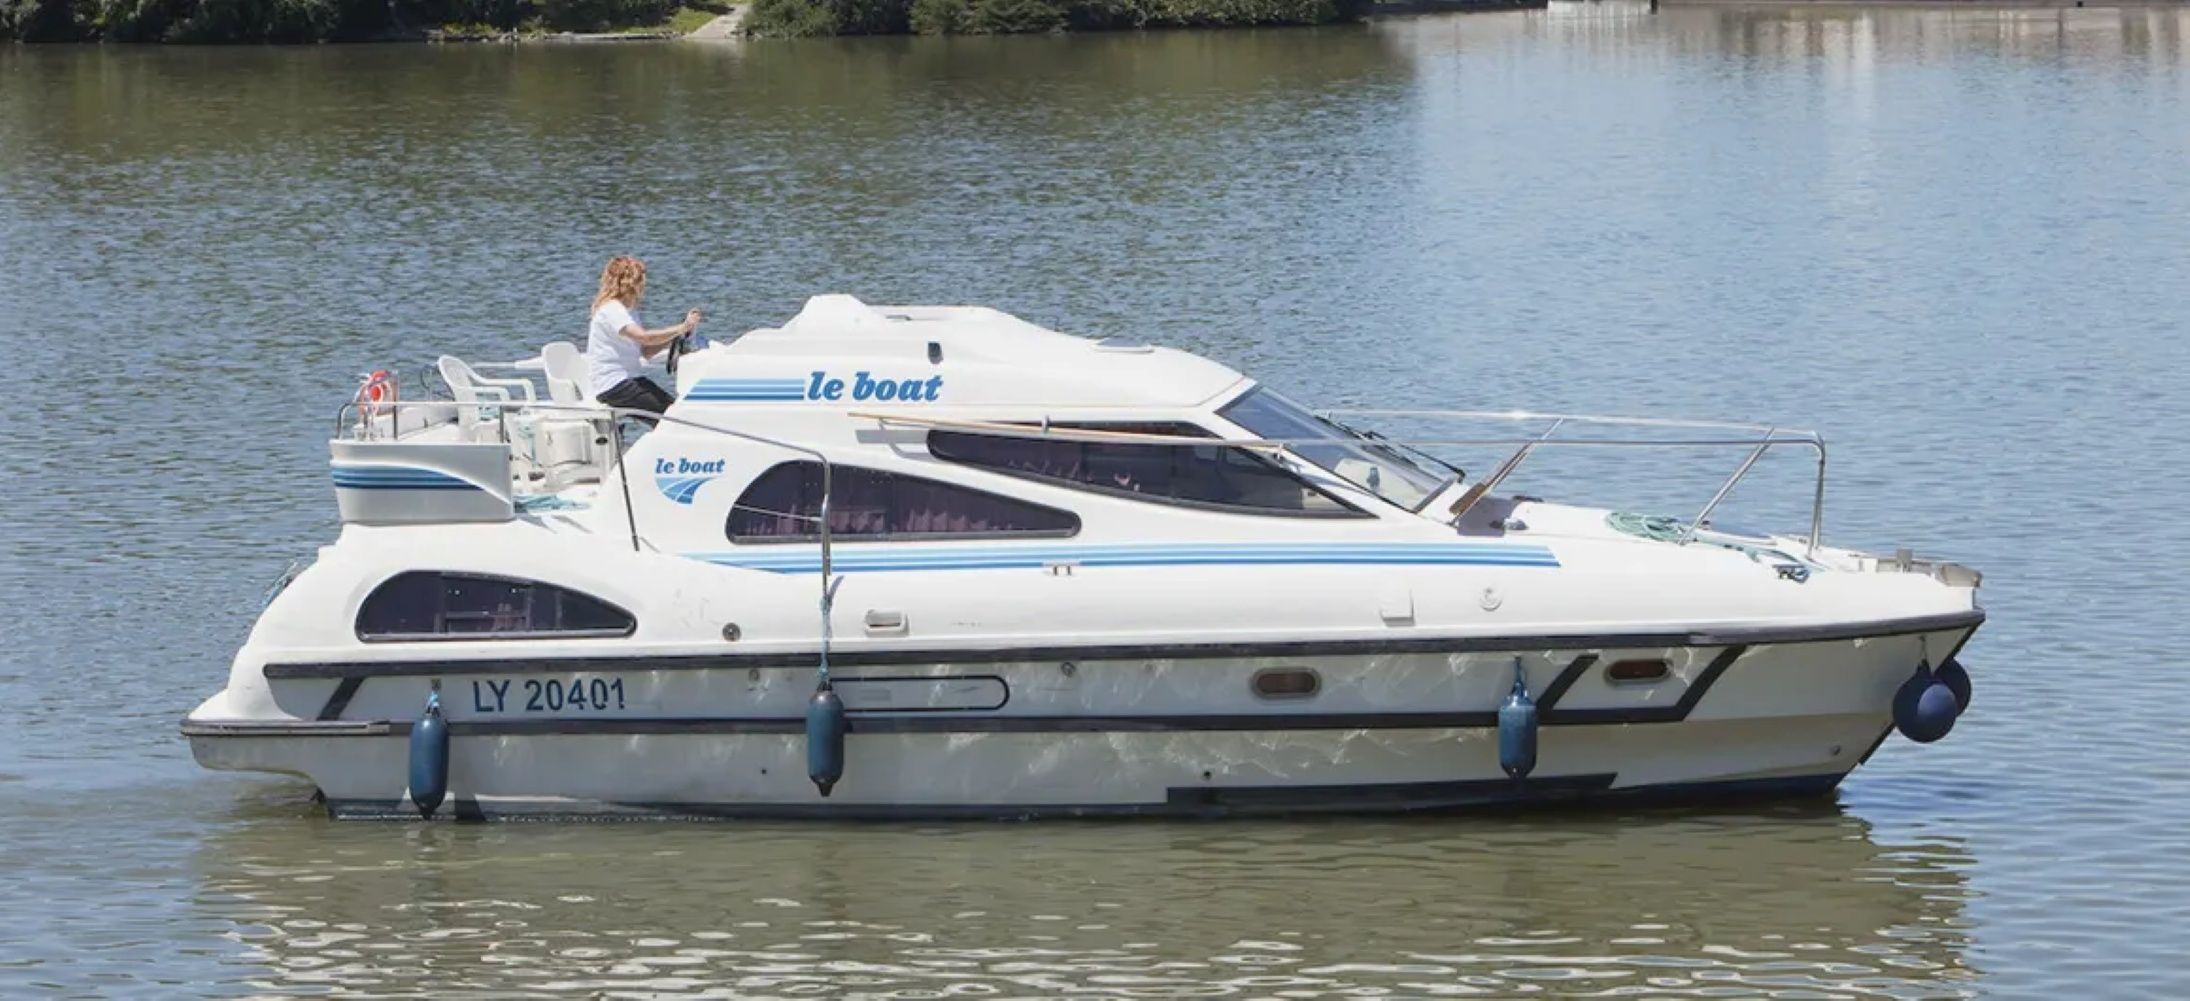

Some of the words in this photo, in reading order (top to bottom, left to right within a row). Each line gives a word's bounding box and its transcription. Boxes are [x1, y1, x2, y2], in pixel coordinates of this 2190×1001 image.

[807, 371, 844, 400] le
[852, 371, 943, 401] boat
[655, 458, 674, 473] le
[679, 458, 725, 473] boat
[473, 680, 511, 712] LY
[524, 677, 625, 711] 20401
